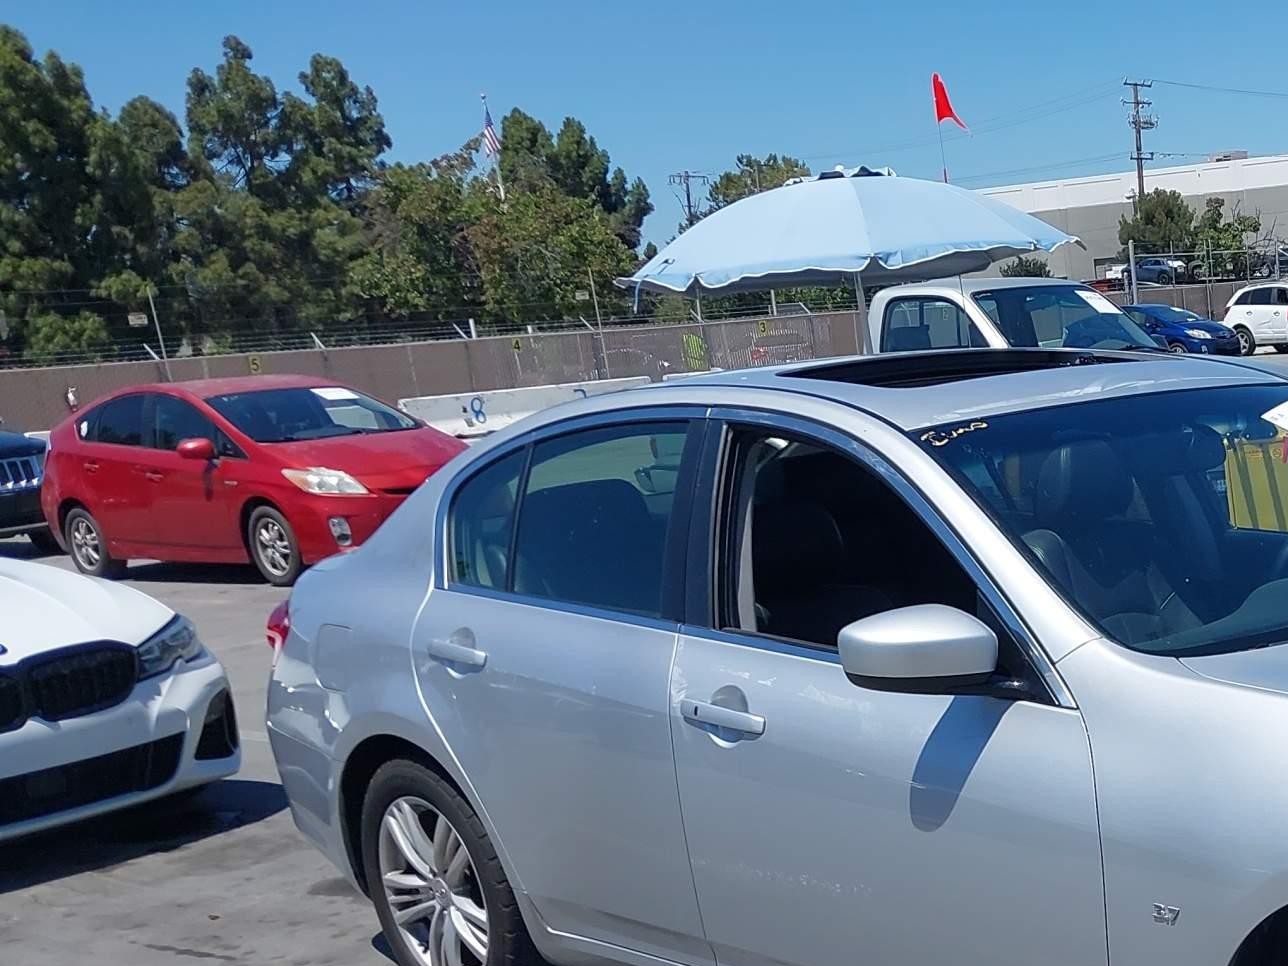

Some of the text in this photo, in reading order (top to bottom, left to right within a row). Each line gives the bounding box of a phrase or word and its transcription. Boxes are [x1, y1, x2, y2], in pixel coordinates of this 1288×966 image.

[759, 322, 766, 333] 3
[513, 339, 521, 352] 4
[251, 358, 260, 371] 5
[470, 397, 487, 424] 8
